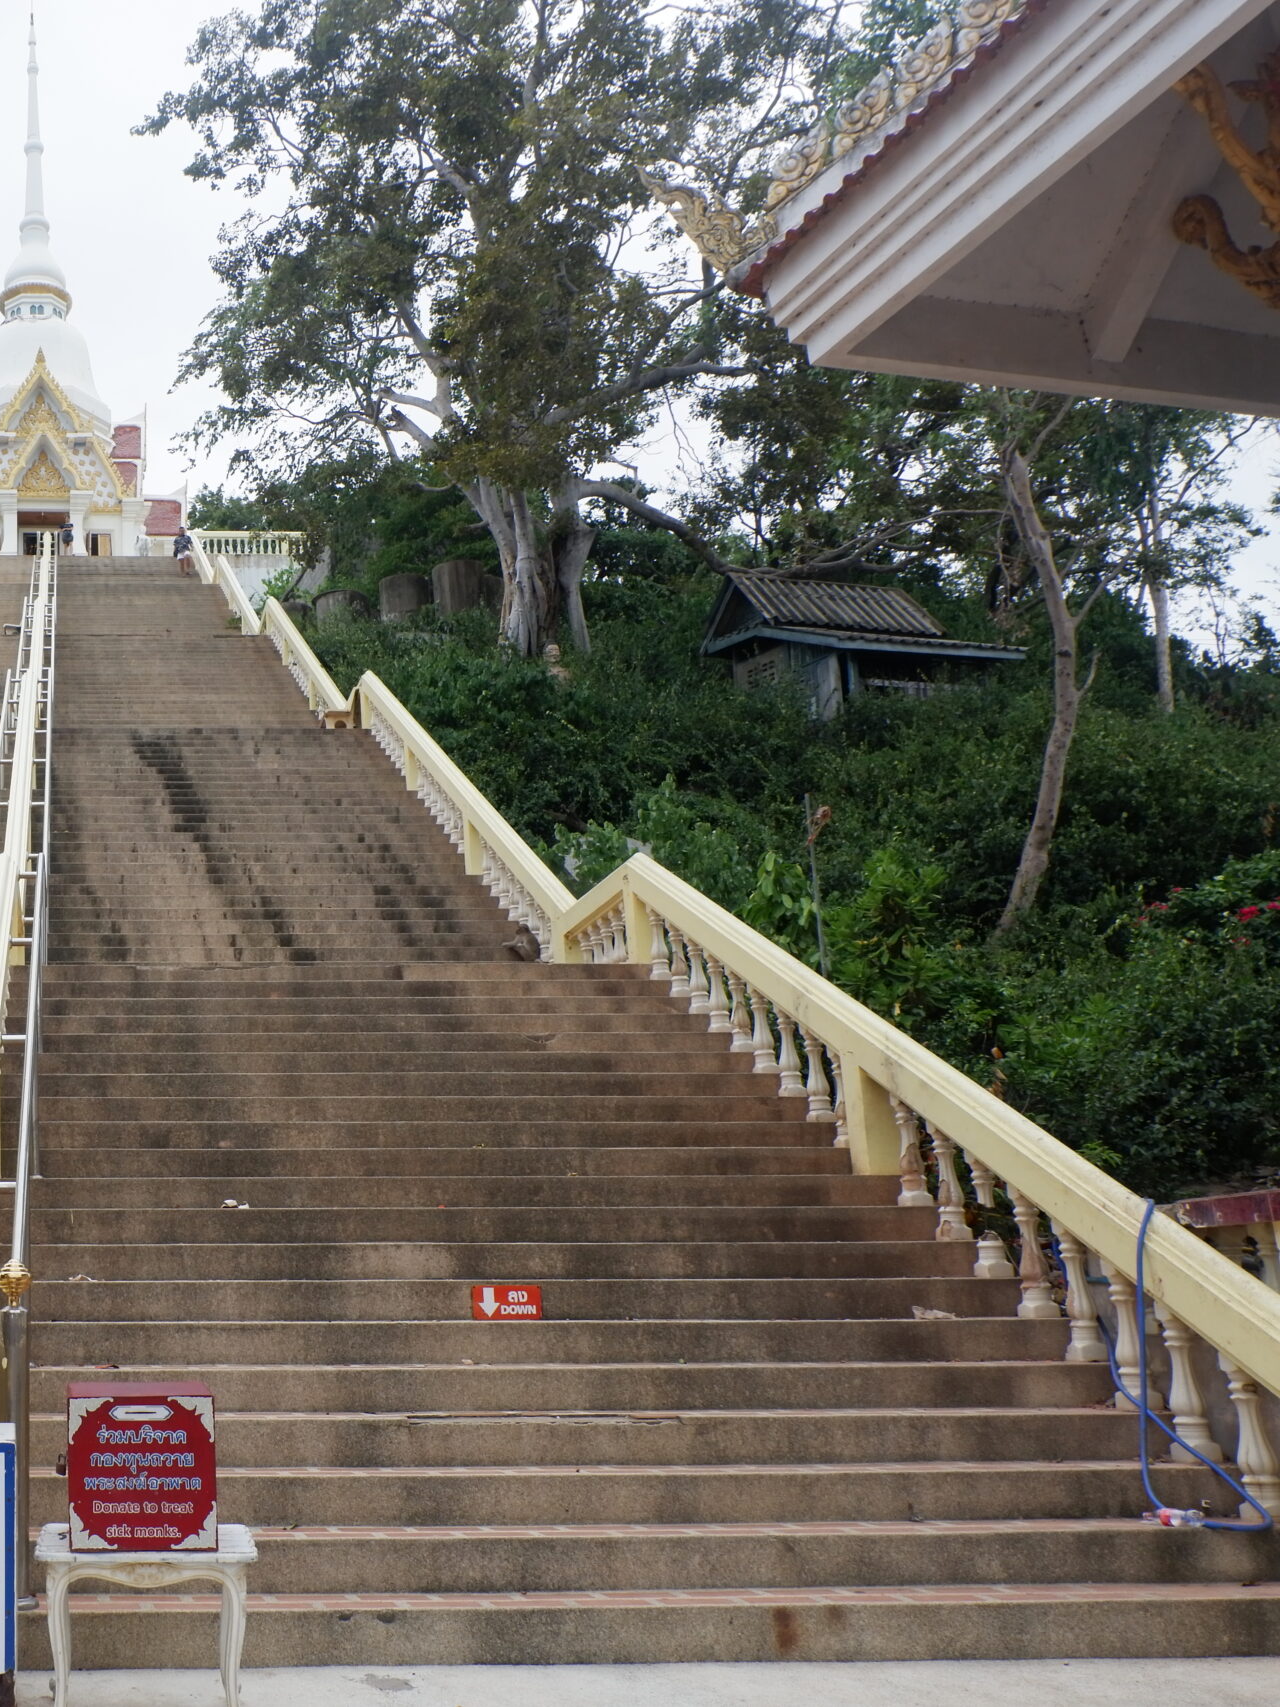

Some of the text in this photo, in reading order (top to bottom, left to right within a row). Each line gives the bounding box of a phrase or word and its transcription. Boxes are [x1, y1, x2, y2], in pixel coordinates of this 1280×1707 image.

[507, 1290, 528, 1303] ลง
[500, 1304, 537, 1315] DOWN
[96, 1424, 187, 1445] ร่วมบริจาค
[90, 1452, 195, 1474] กองทุนถวาย
[92, 1501, 194, 1514] Donate to treat
[106, 1524, 182, 1538] sick monks.
